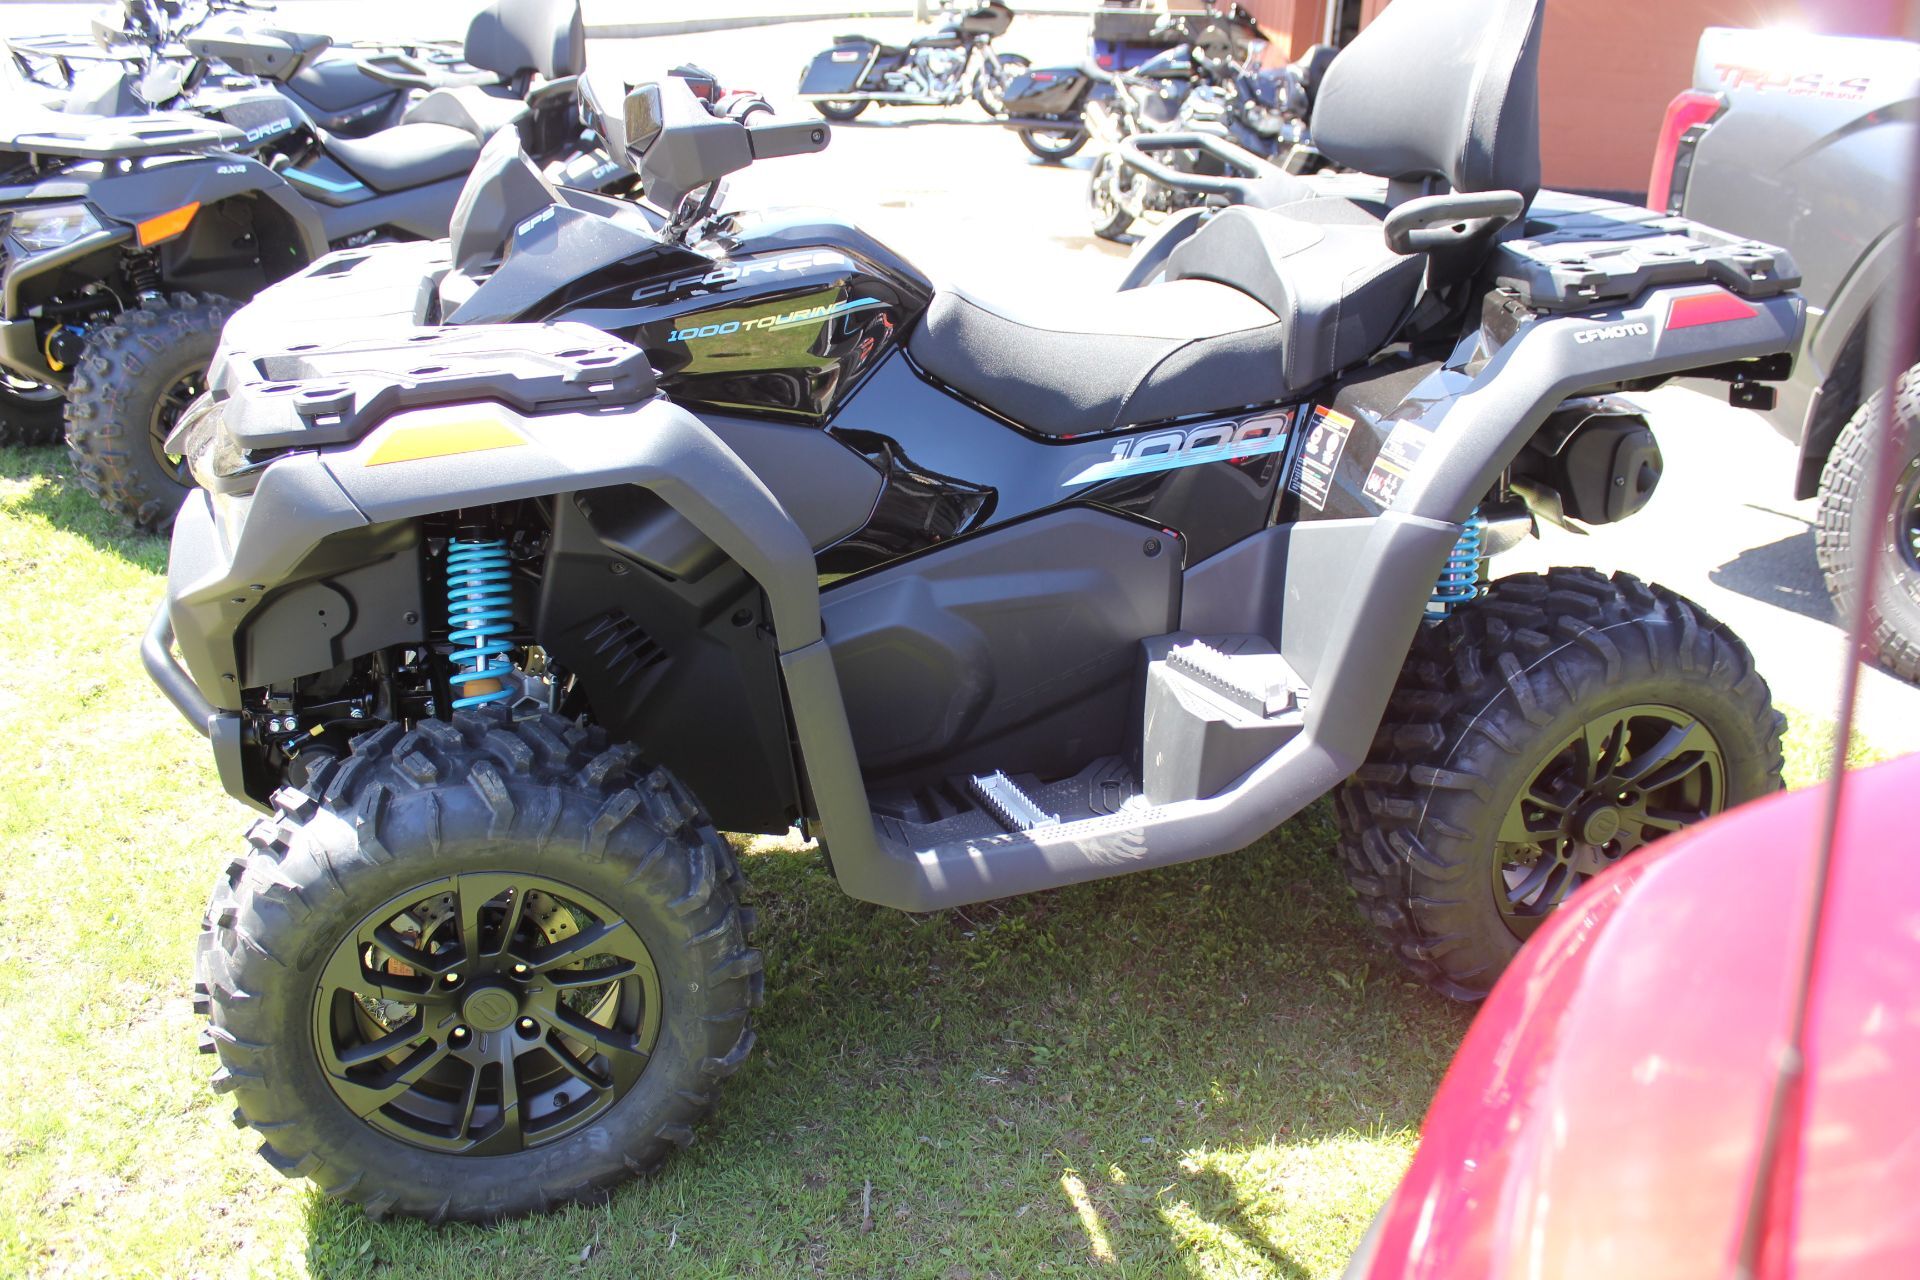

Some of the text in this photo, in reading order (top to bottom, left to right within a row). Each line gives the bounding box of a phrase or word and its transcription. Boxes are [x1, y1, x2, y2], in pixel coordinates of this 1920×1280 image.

[246, 117, 293, 142] ORCE
[518, 206, 555, 236] EPS
[631, 251, 846, 301] CFORCE
[667, 299, 848, 343] 1000 TOURING
[1573, 322, 1649, 344] CFMOTO
[1110, 413, 1289, 463] 1000
